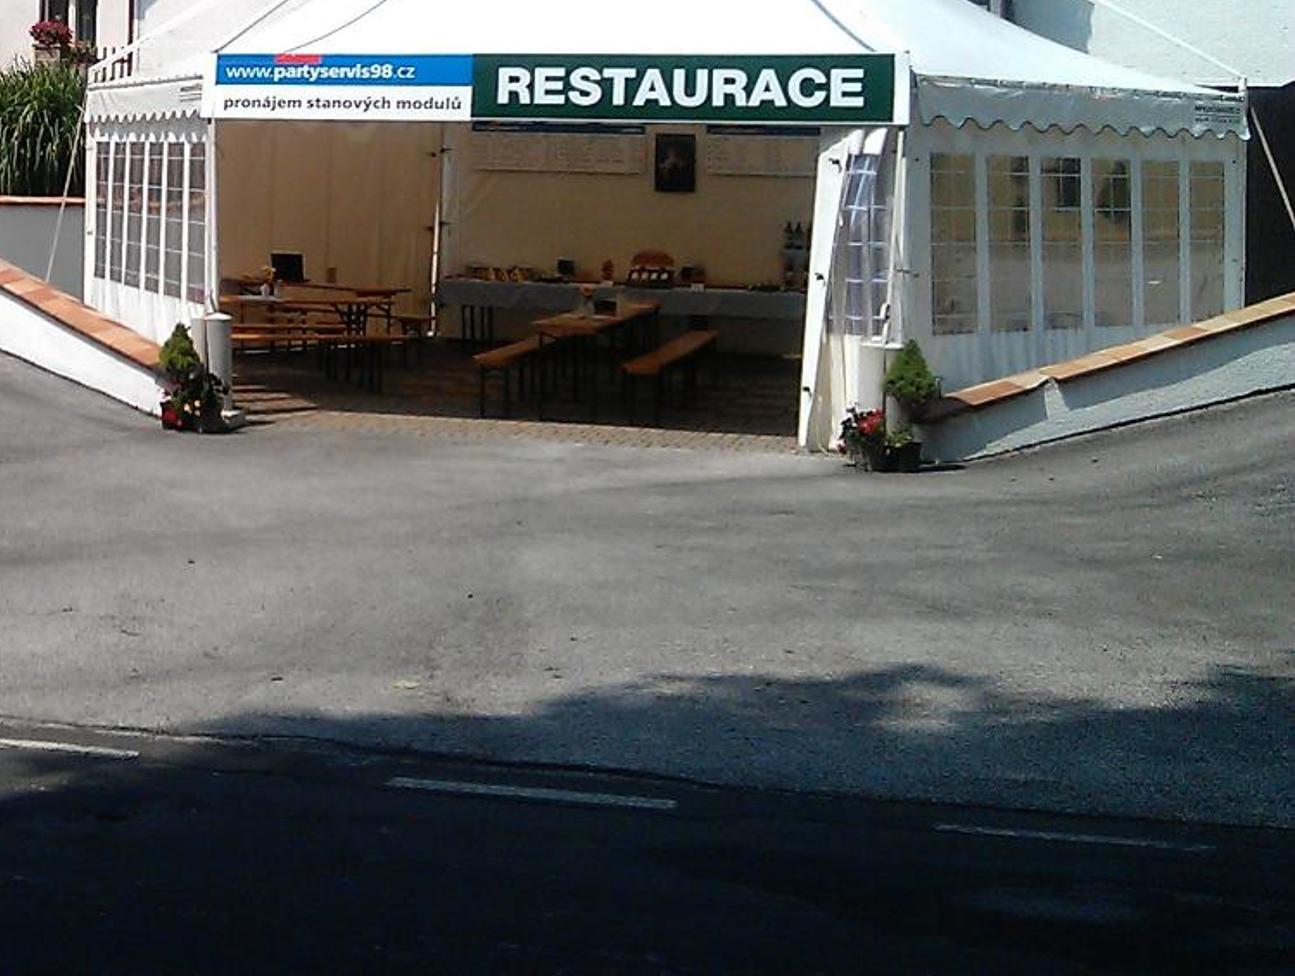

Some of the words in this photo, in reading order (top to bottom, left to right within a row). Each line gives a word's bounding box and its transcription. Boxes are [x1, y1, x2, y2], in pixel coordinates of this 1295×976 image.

[226, 63, 416, 82] www.partyservis98.cz
[497, 67, 864, 107] RESTAURACE
[223, 95, 302, 111] pronájem
[307, 96, 391, 112] stanových
[396, 96, 462, 111] modulů
